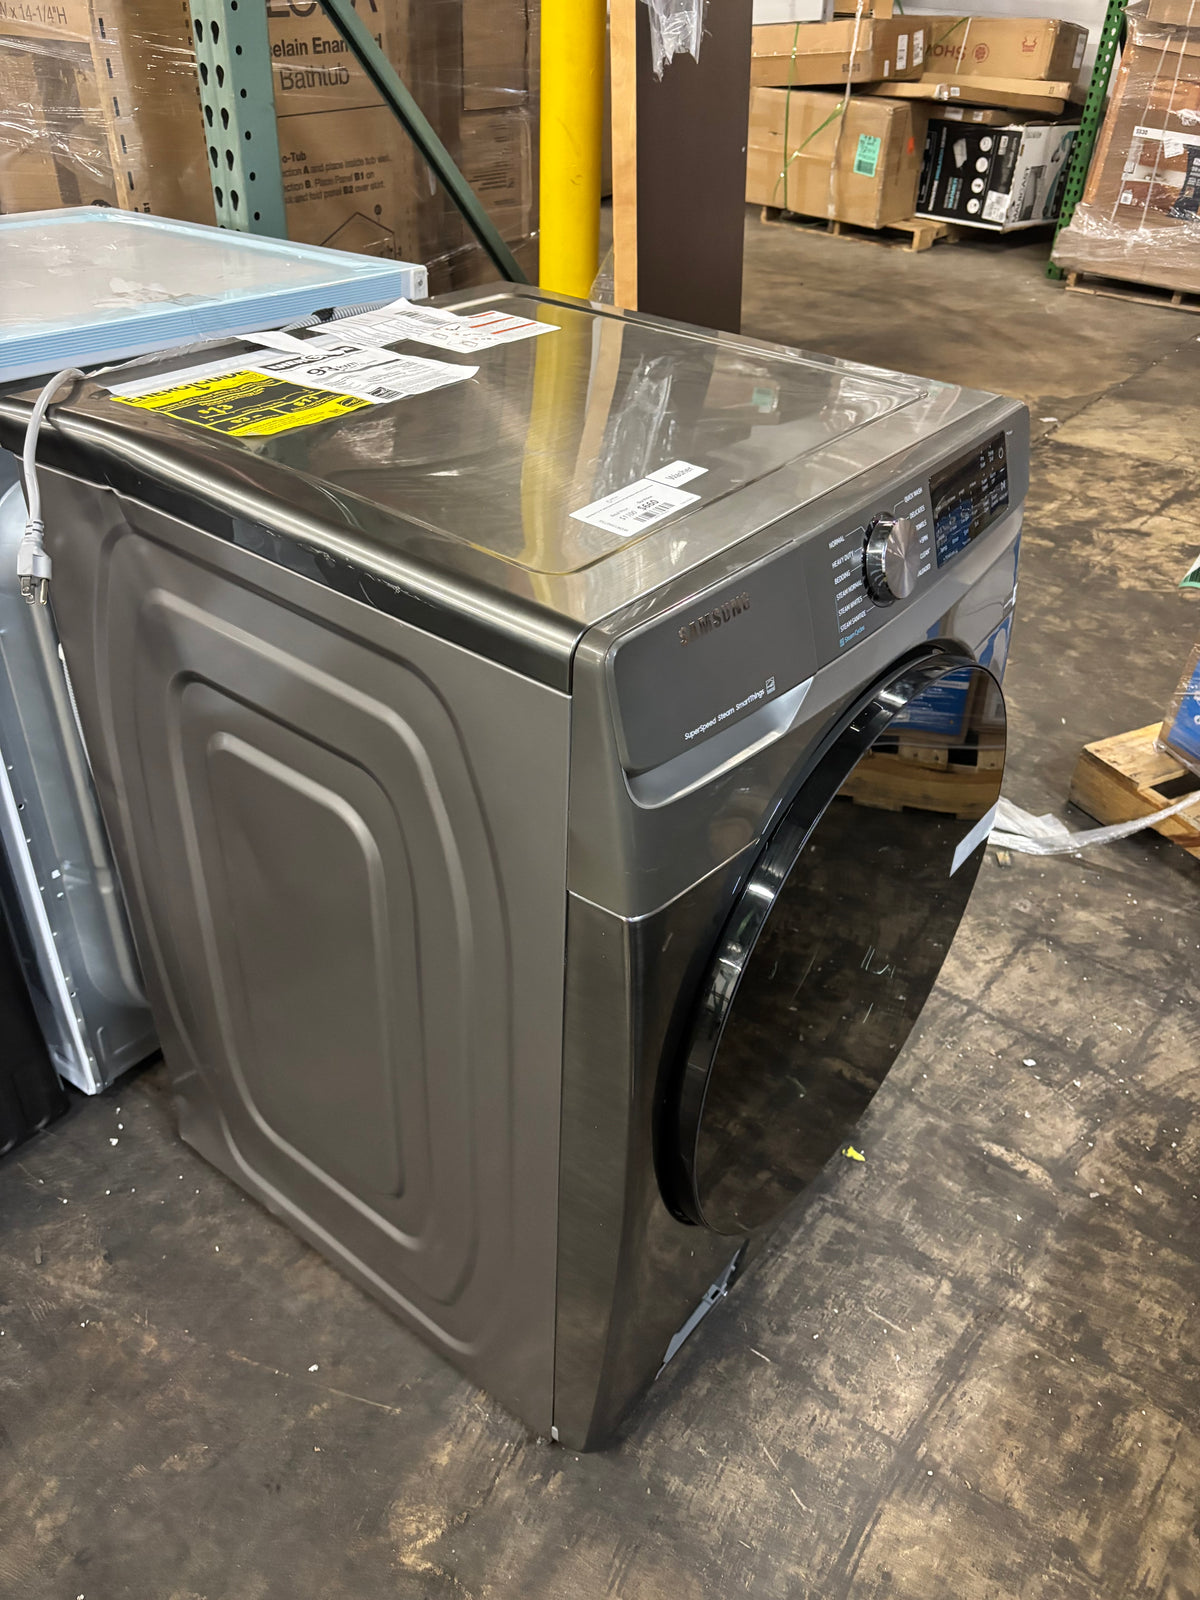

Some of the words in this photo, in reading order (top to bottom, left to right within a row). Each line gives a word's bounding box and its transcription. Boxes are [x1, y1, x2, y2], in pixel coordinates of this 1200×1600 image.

[270, 38, 308, 57] elain
[280, 63, 350, 91] Bathtub
[834, 570, 851, 585] BEDDING
[678, 591, 751, 647] SAMSUNG
[684, 717, 717, 740] SuperSpeed
[718, 707, 735, 721] Steam
[736, 689, 765, 711] SmartThings
